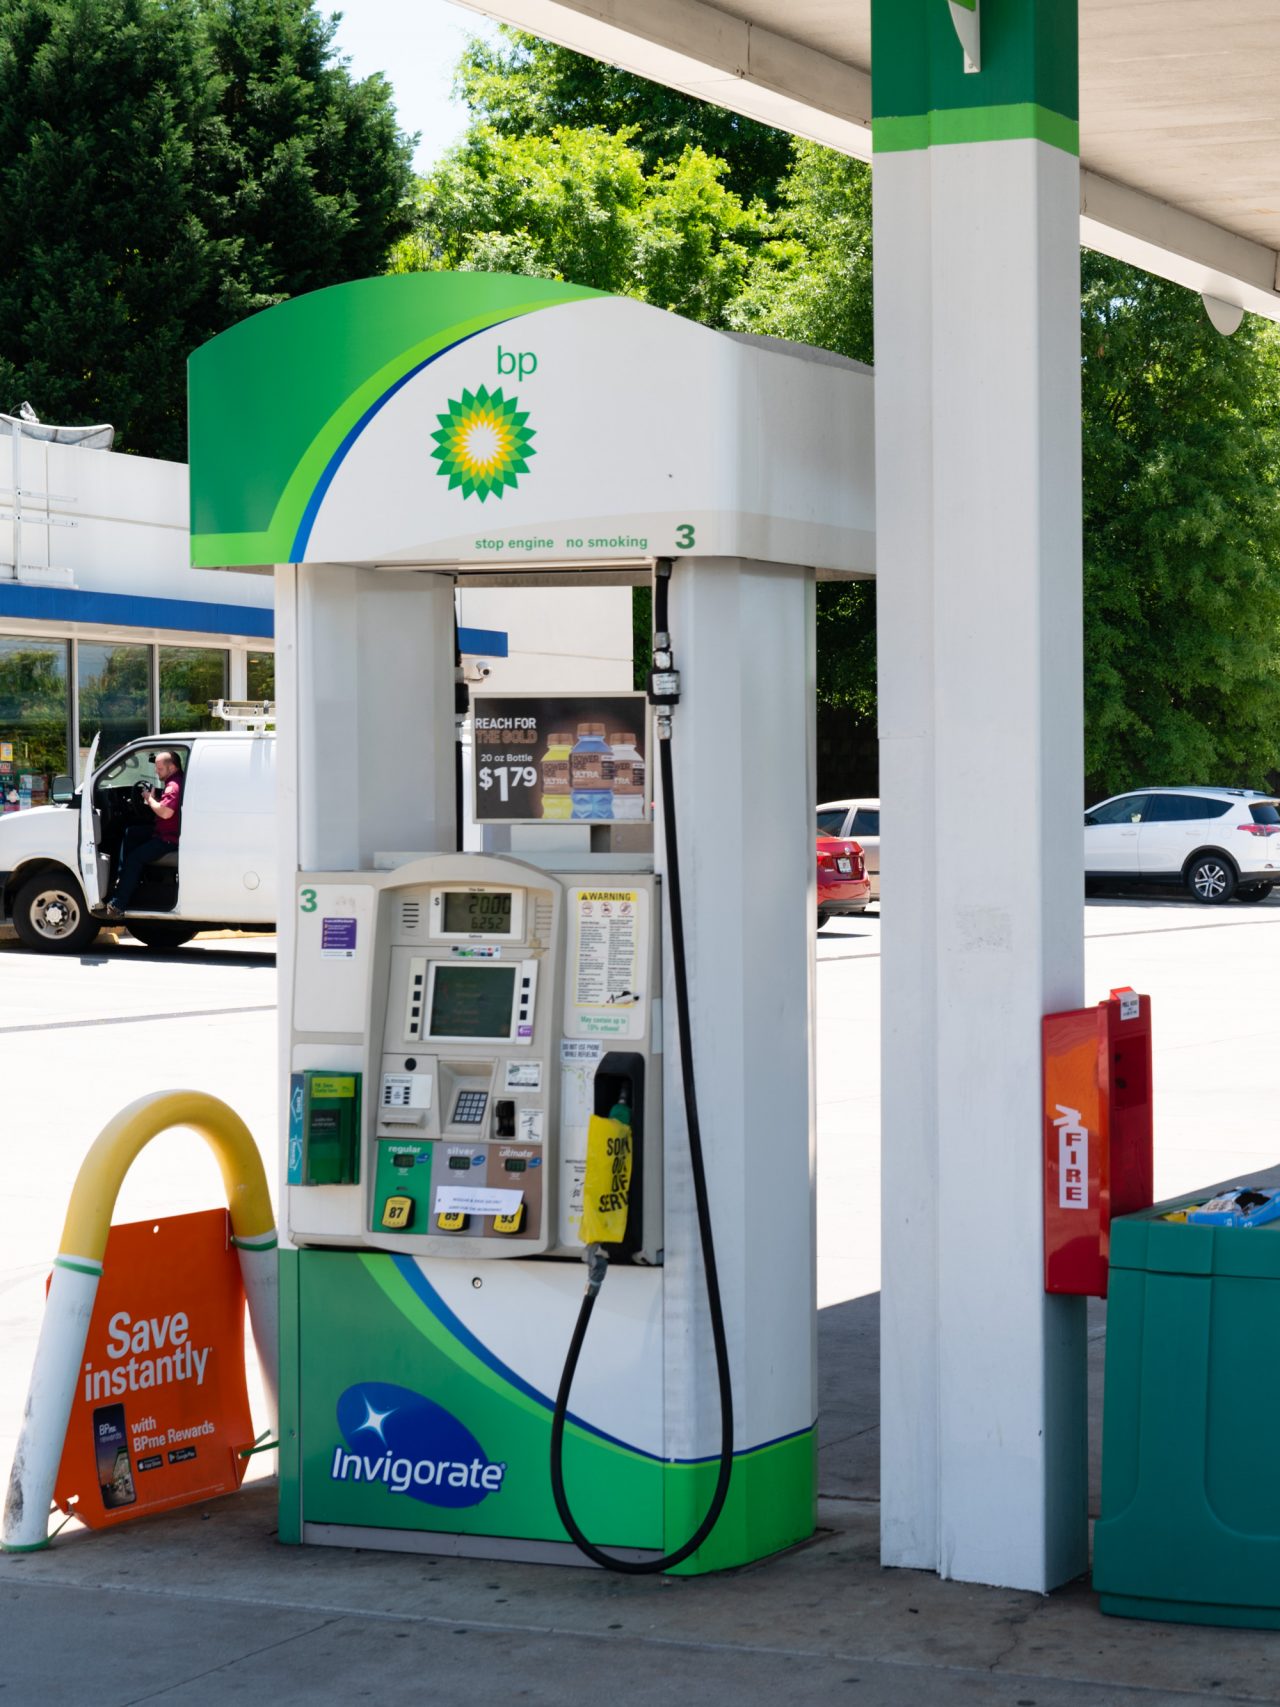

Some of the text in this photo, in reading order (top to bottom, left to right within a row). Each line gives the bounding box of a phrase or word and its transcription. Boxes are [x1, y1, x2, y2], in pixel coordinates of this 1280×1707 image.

[497, 344, 538, 382] bp
[475, 535, 648, 550] stop engine no smoking
[675, 524, 695, 549] 3
[475, 717, 537, 729] REACH FOR
[481, 754, 492, 762] 20
[506, 754, 533, 762] Bottle
[300, 888, 318, 912] 3
[589, 892, 631, 901] WARNING
[388, 1145, 421, 1154] regular
[447, 1147, 475, 1156] silver
[498, 1148, 534, 1158] ultimate
[1065, 1133, 1082, 1202] FIRE
[389, 1206, 404, 1219] 87
[500, 1213, 515, 1224] 93
[106, 1311, 189, 1360] Save
[85, 1341, 209, 1402] instantly
[131, 1416, 157, 1434] with
[133, 1421, 215, 1453] BPme Rewards
[332, 1447, 504, 1492] Invigorate
